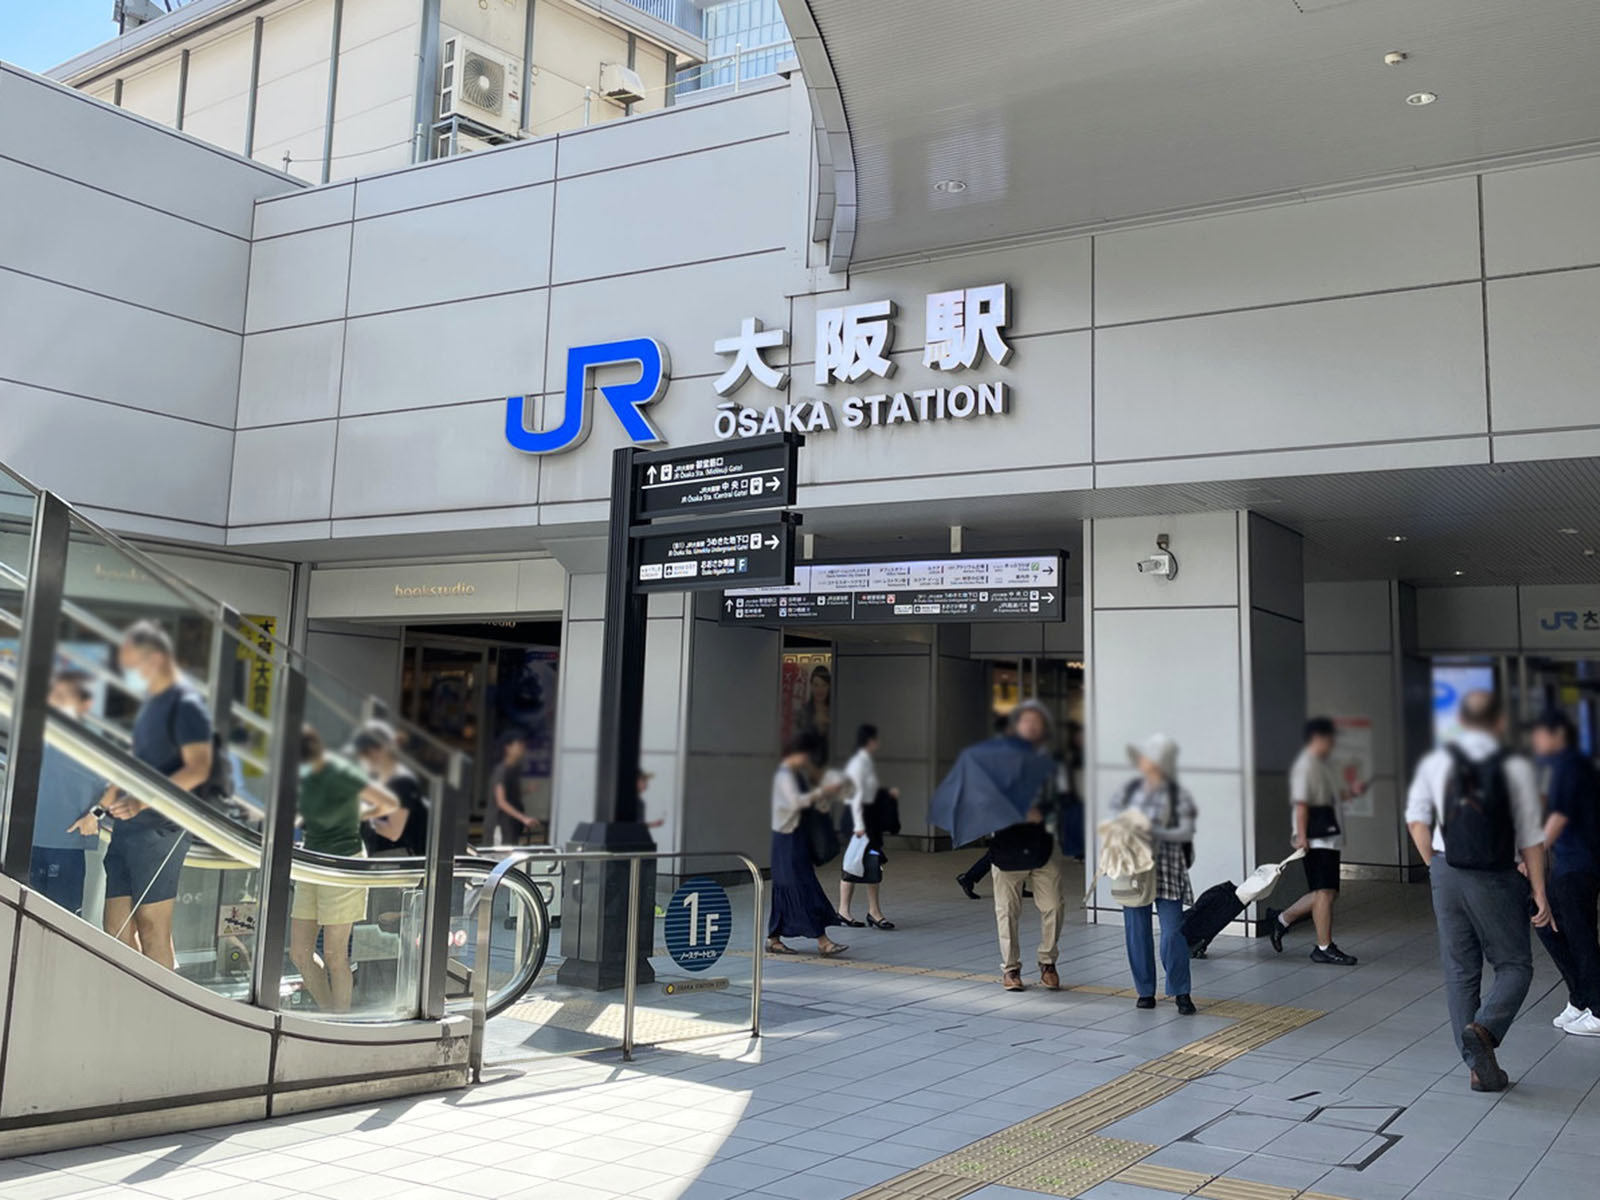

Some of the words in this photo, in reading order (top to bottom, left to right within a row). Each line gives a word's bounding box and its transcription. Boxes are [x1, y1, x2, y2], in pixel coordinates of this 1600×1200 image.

[712, 283, 1011, 397] 大阪駅
[505, 337, 667, 455] JR
[841, 381, 1004, 428] STATION
[1541, 611, 1578, 631] JR
[683, 892, 720, 947] 1F
